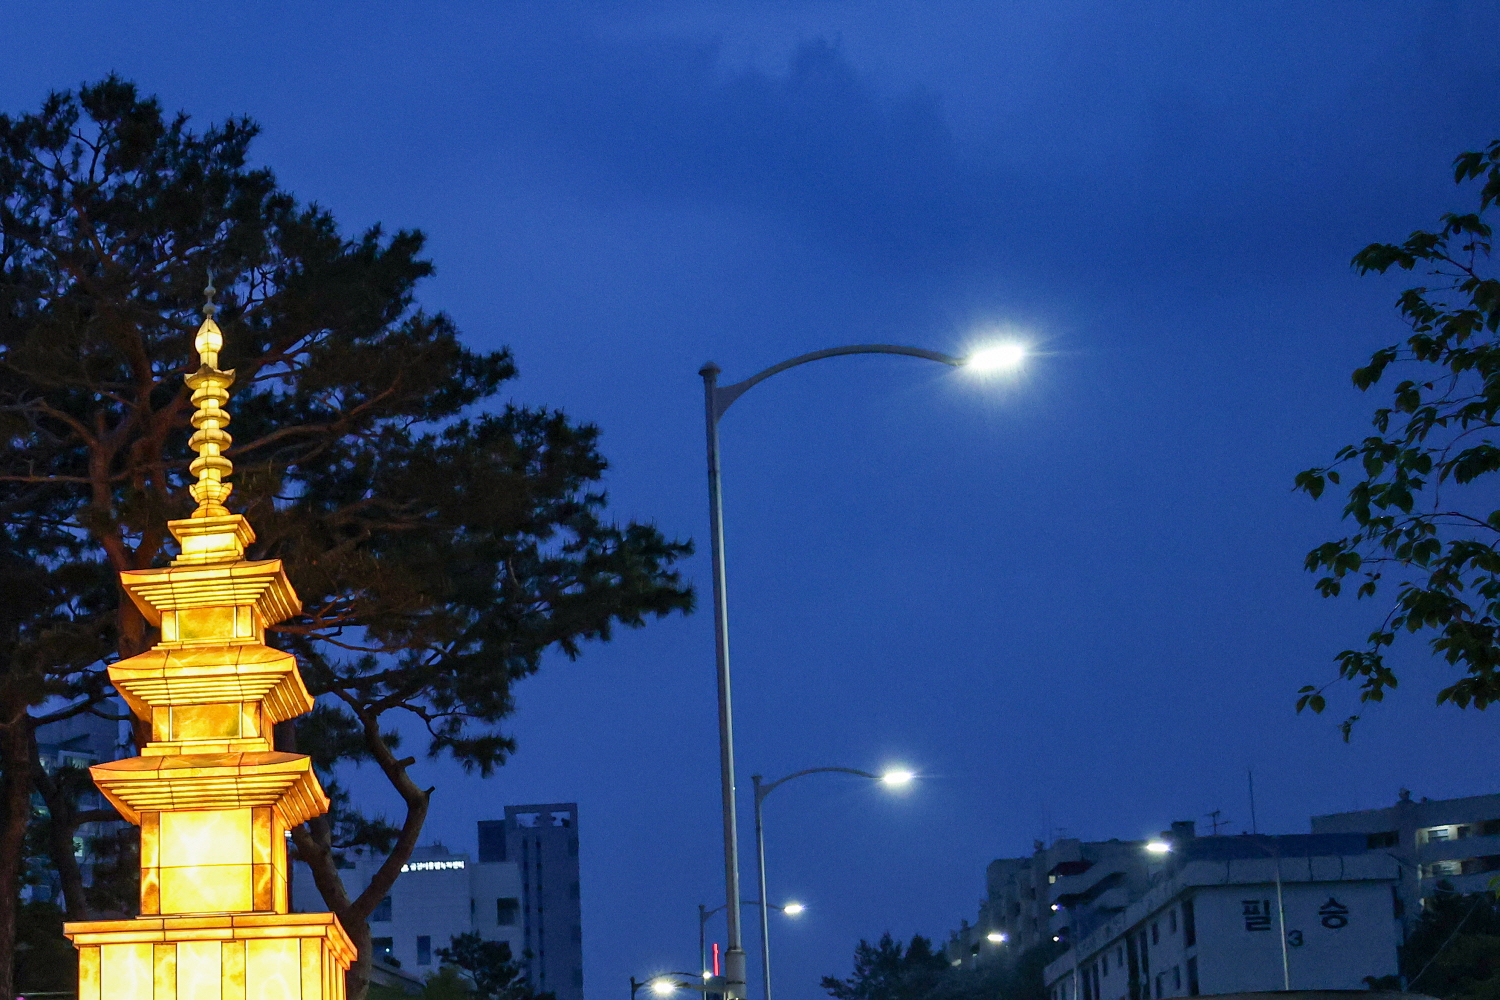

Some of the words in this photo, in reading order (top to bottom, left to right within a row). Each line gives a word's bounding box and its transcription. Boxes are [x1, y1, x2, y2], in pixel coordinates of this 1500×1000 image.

[1241, 899, 1272, 932] 필
[1318, 896, 1349, 929] 승
[1287, 929, 1304, 947] 3
